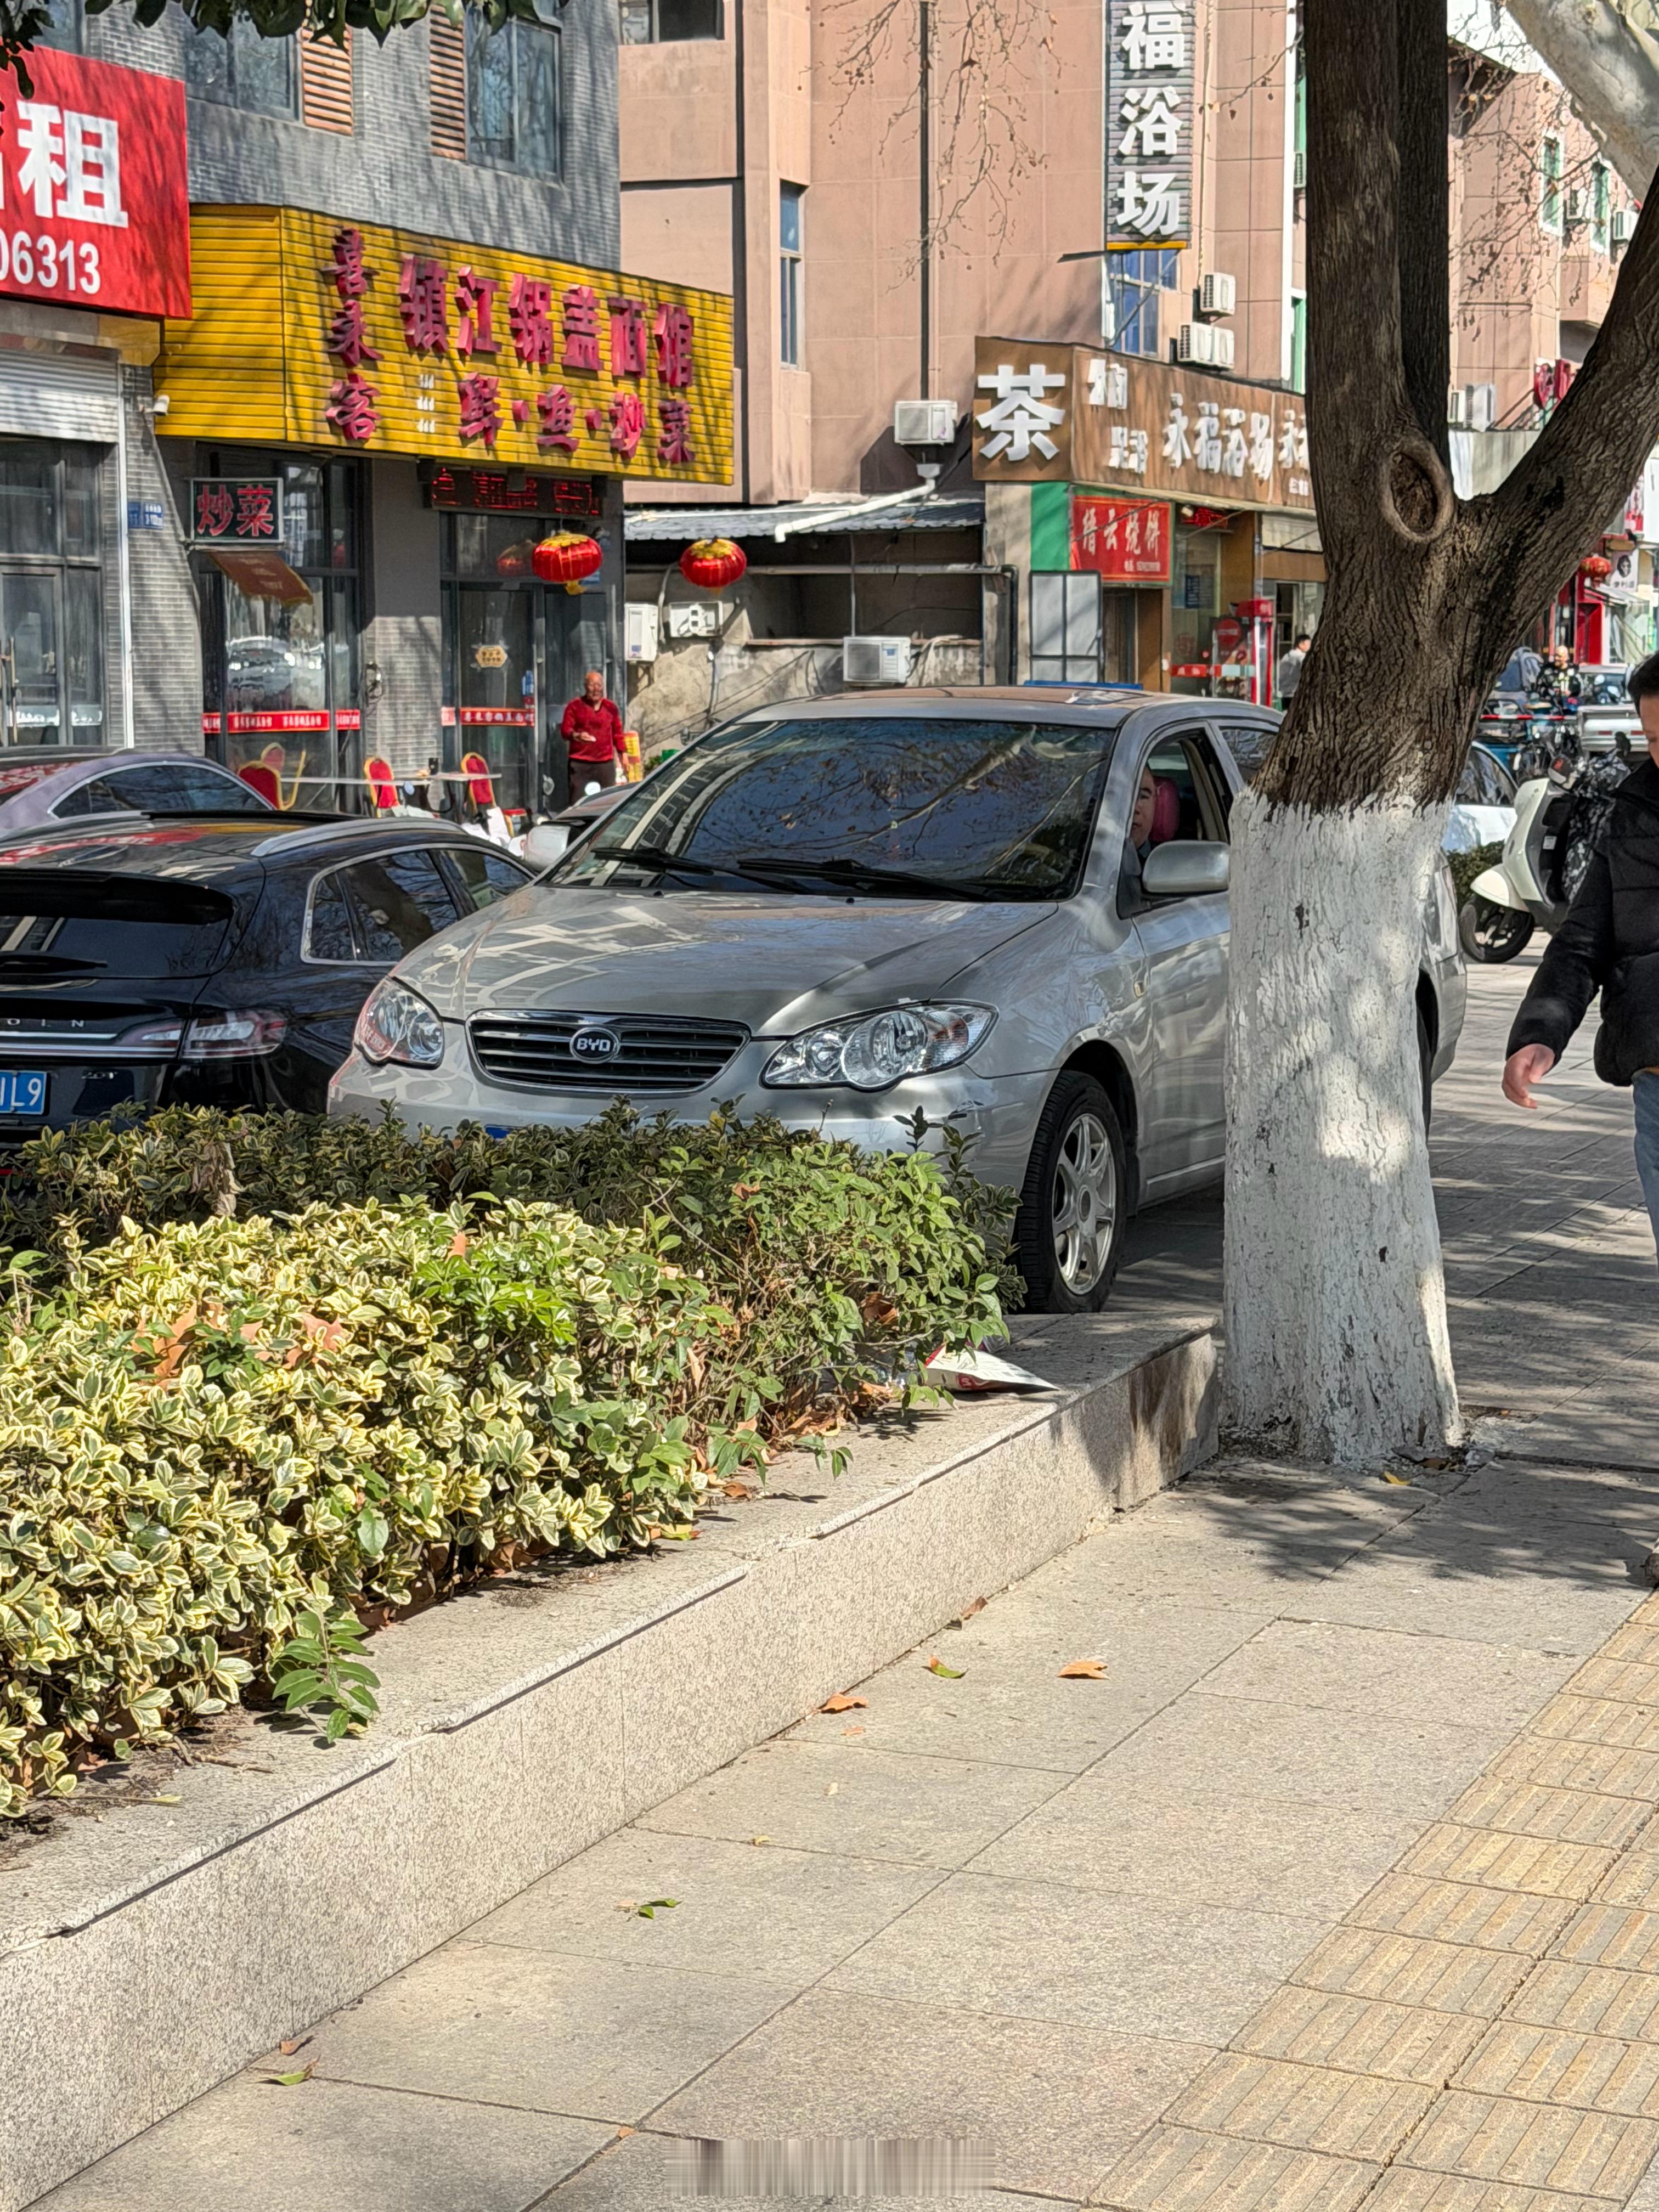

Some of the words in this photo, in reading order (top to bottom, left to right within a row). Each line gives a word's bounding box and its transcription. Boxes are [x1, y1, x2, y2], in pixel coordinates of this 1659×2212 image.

[0, 99, 128, 228] 租
[1116, 2, 1185, 236] 福浴场
[399, 252, 695, 388] 镇江锅盖面馆
[976, 364, 1065, 462] 茶
[198, 483, 275, 537] 炒菜
[577, 1037, 611, 1052] BYD
